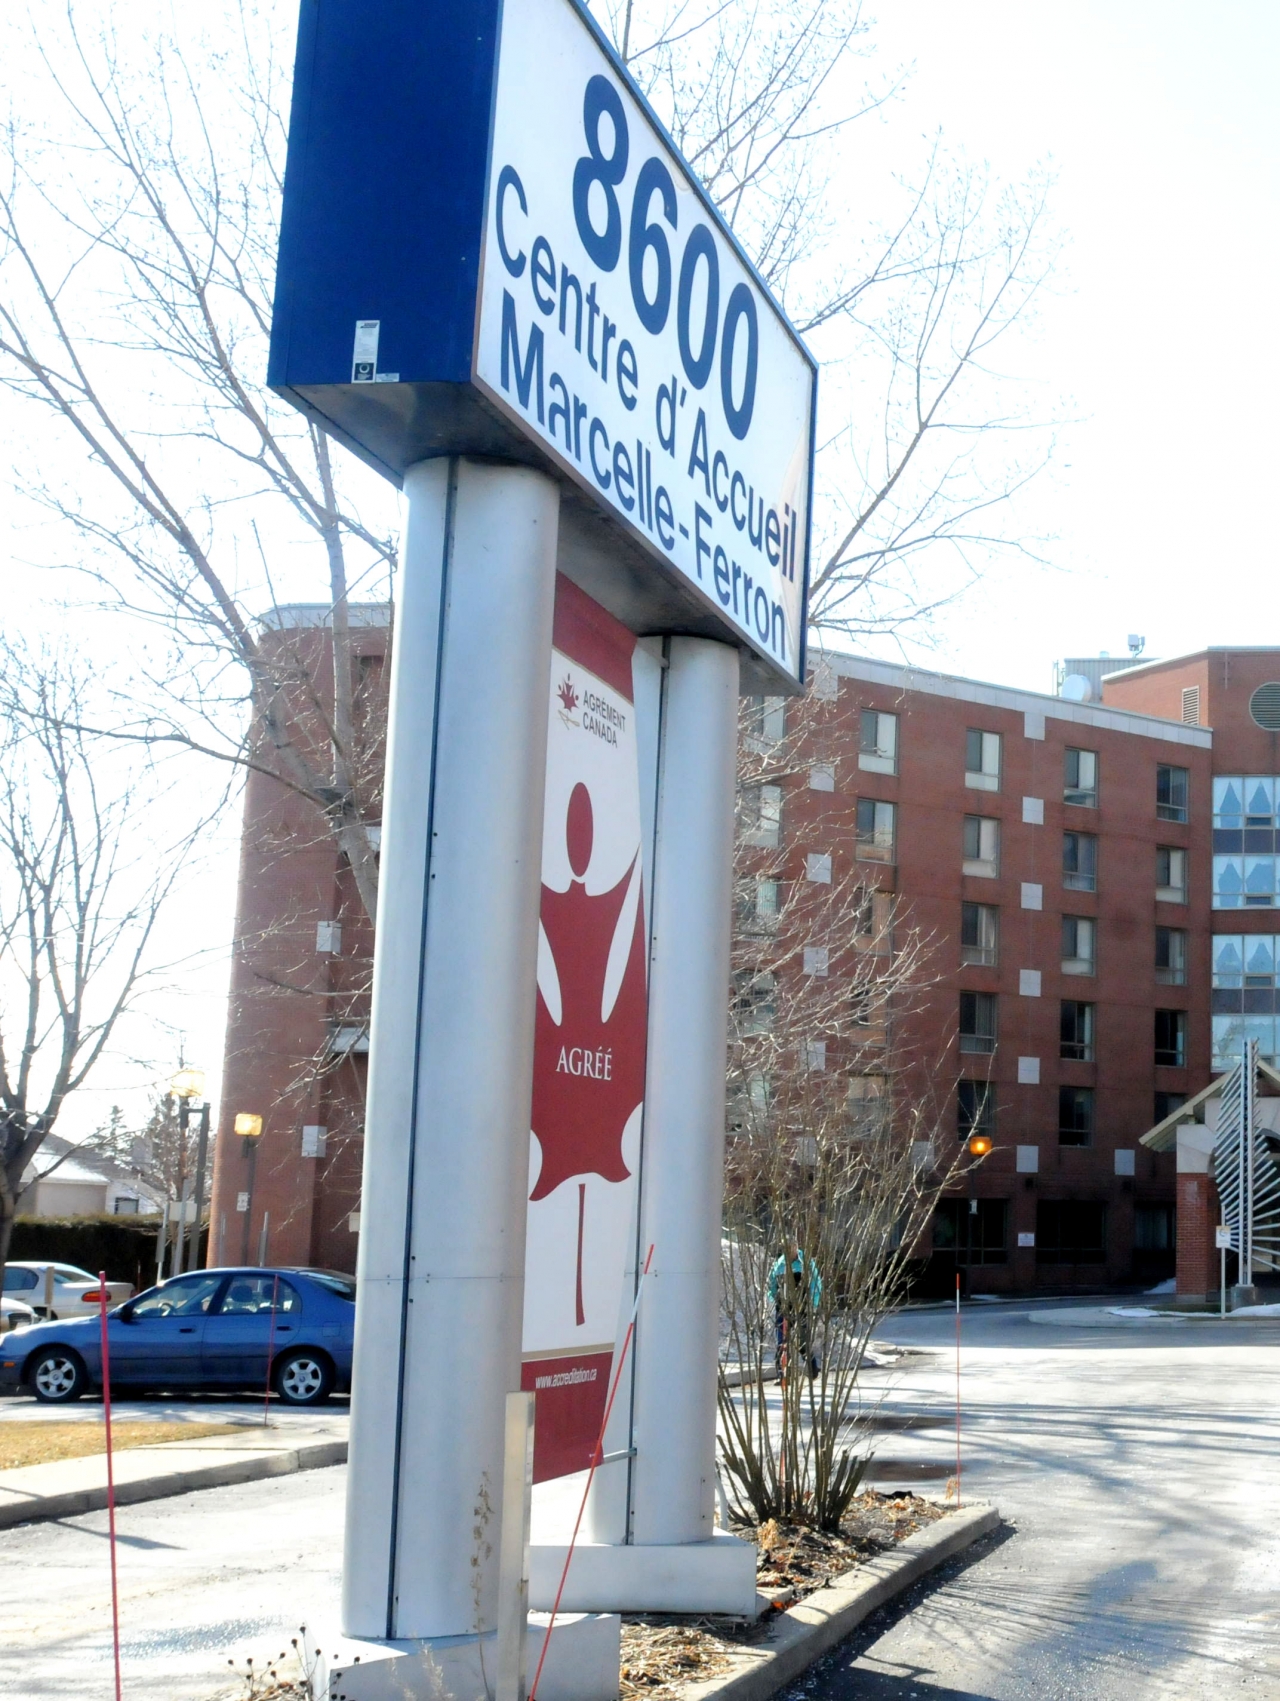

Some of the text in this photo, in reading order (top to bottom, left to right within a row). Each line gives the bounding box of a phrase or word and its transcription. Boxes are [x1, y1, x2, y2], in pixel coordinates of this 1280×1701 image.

[572, 74, 759, 441] 8600
[496, 164, 797, 583] Centre d'Accueil
[500, 287, 787, 660] Marcelle-Ferron
[583, 690, 626, 732] AGRÉMENT
[583, 712, 618, 748] CANADA
[556, 1045, 612, 1081] AGRÉÉ
[535, 1367, 598, 1389] www.accreditation.ca
